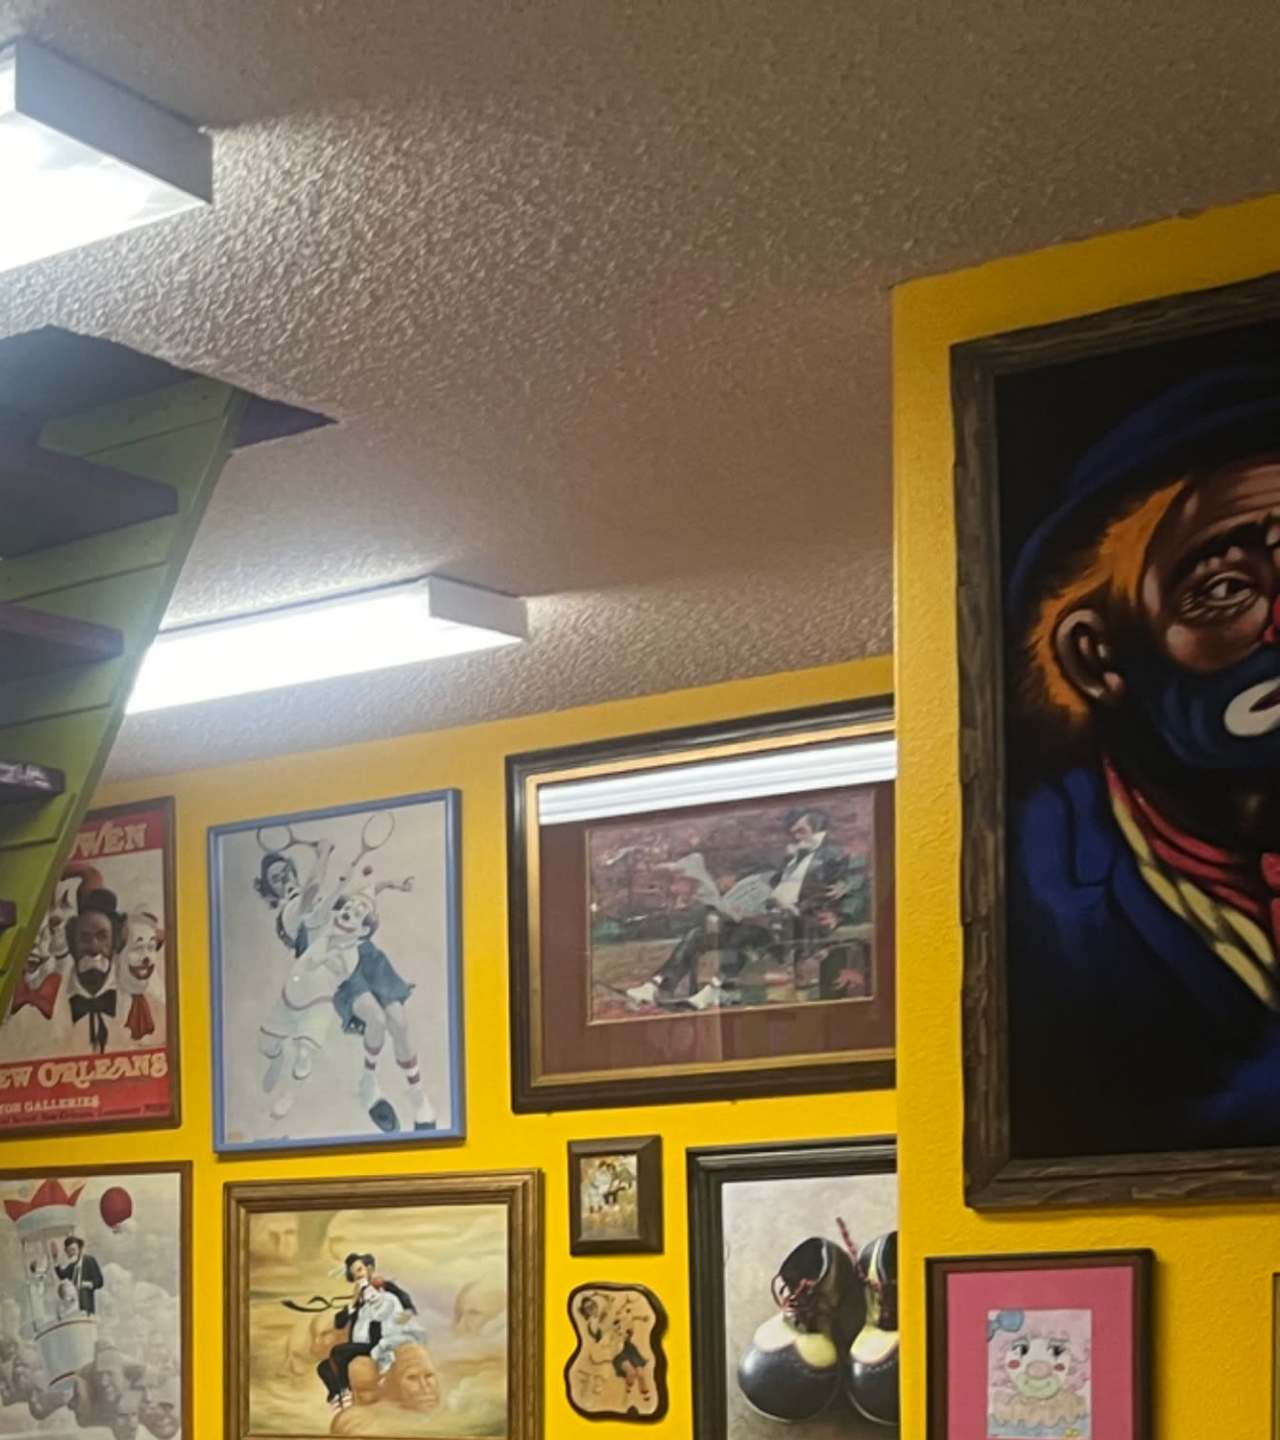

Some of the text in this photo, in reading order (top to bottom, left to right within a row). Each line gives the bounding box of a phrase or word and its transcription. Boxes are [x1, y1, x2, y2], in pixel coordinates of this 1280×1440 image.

[68, 820, 147, 859] WEN
[37, 1052, 168, 1089] ORLEANS
[24, 1095, 100, 1113] GALLERIES
